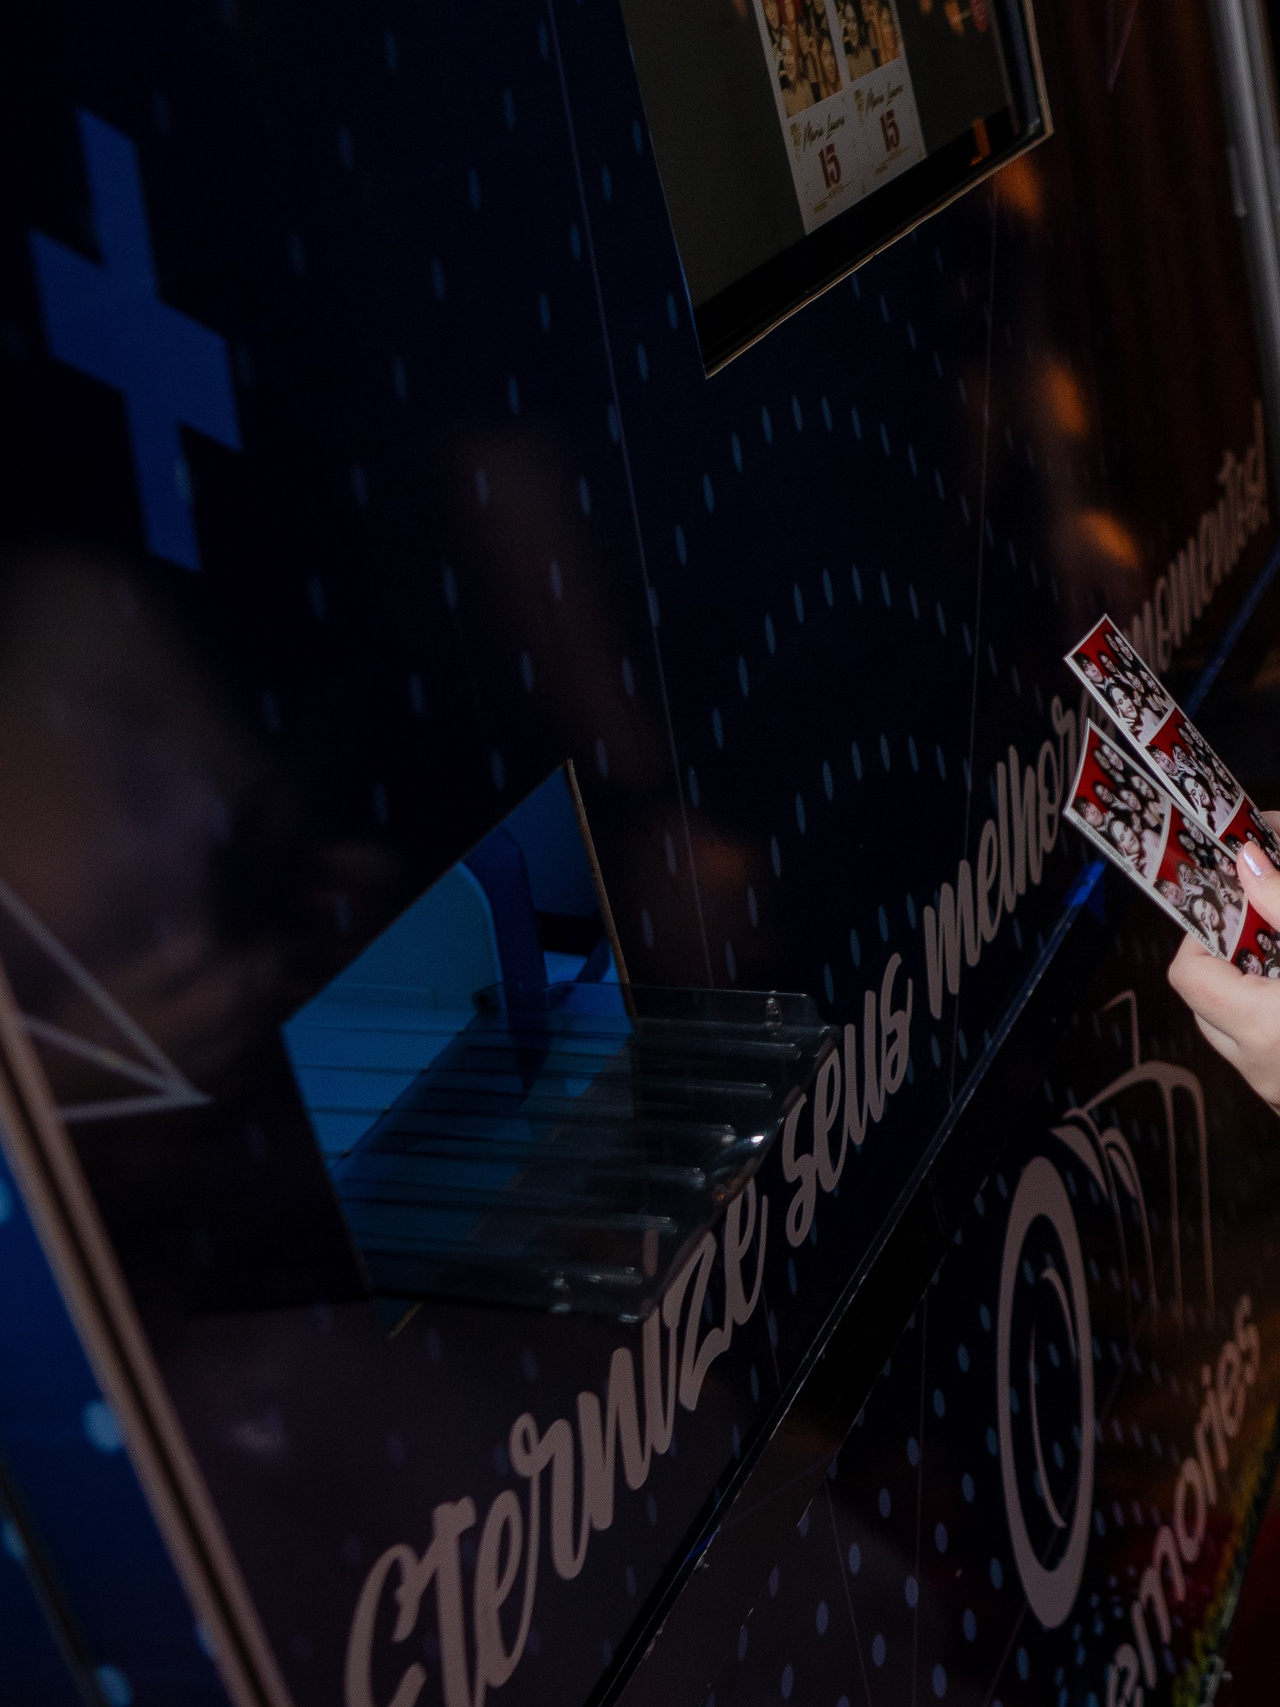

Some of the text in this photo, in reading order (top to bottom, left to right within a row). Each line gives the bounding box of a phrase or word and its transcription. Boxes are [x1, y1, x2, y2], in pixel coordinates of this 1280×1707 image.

[880, 109, 900, 152] 15
[818, 143, 841, 190] 15
[781, 952, 914, 1247] seus
